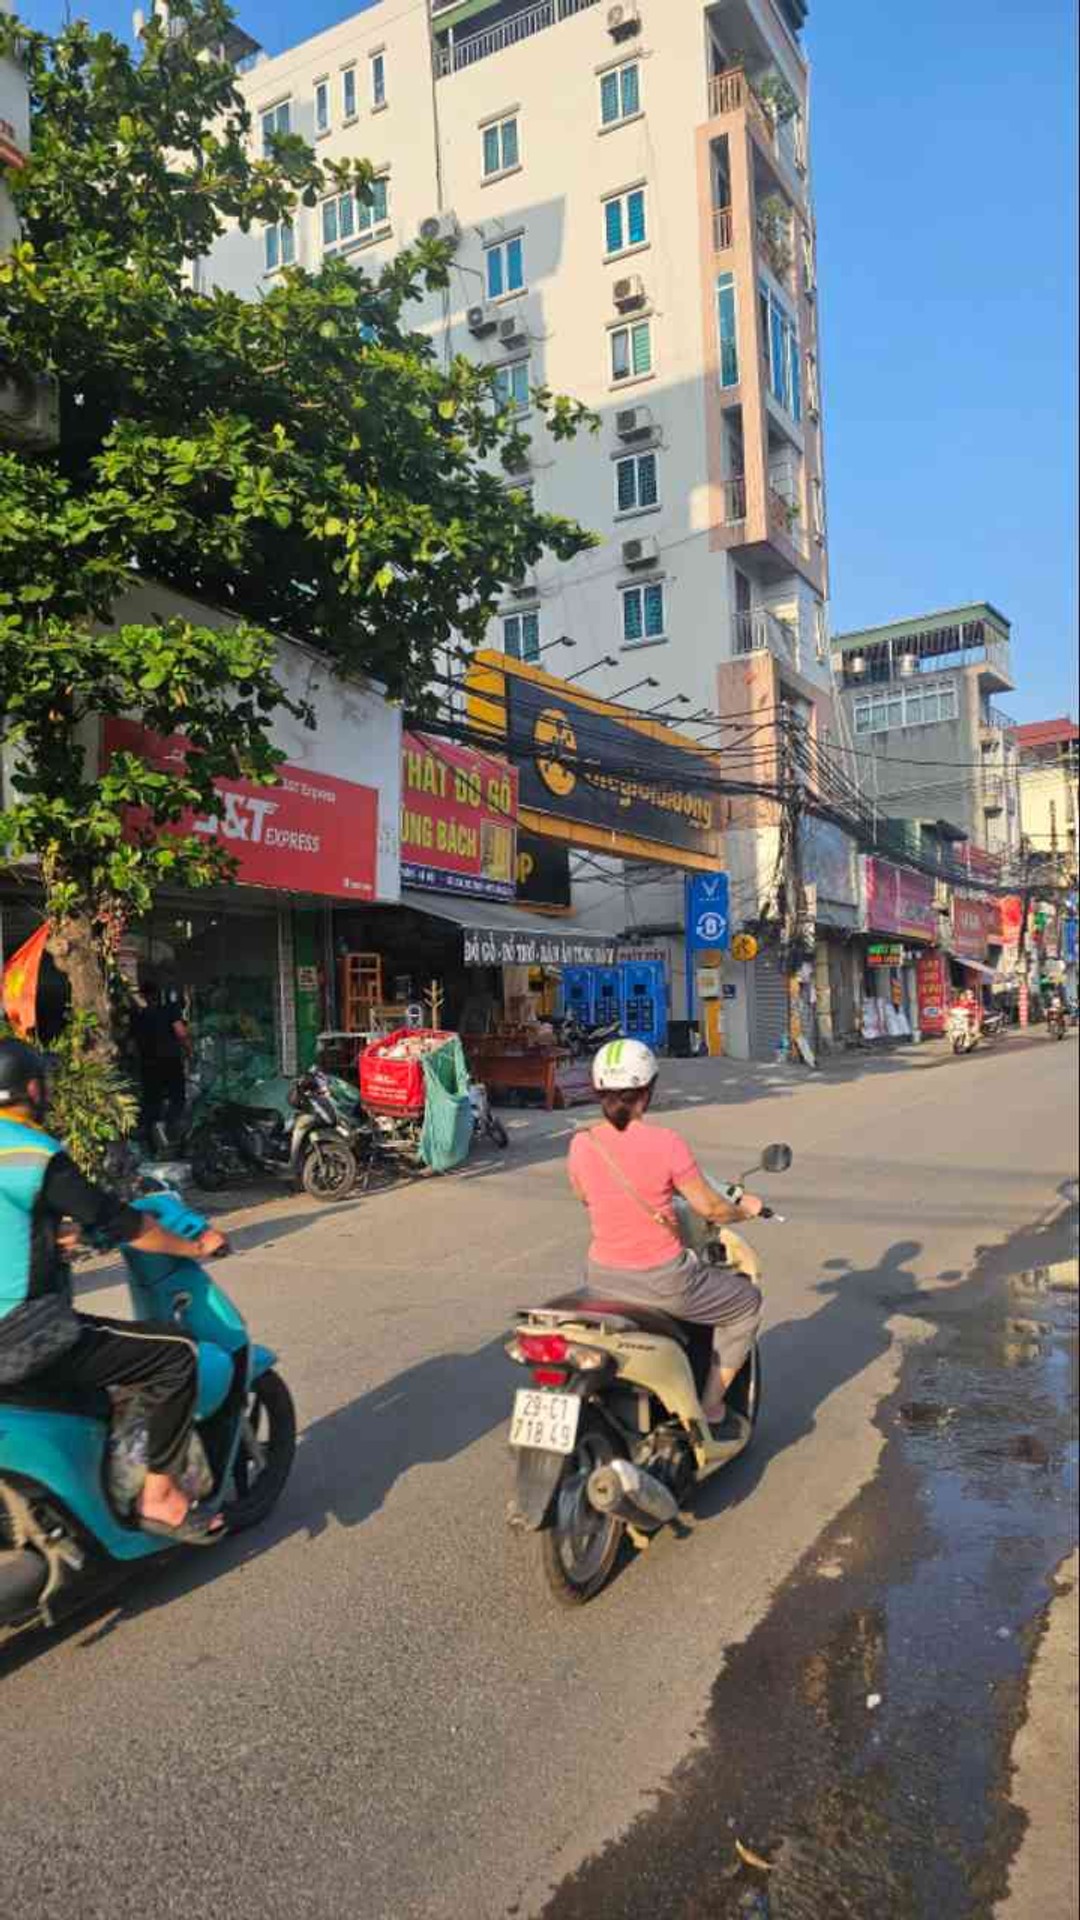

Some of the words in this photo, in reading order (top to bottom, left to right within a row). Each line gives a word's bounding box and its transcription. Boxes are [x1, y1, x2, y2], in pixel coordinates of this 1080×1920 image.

[402, 748, 447, 798] HẤT
[264, 827, 320, 853] EXPRESS
[523, 1394, 568, 1420] 29-C1
